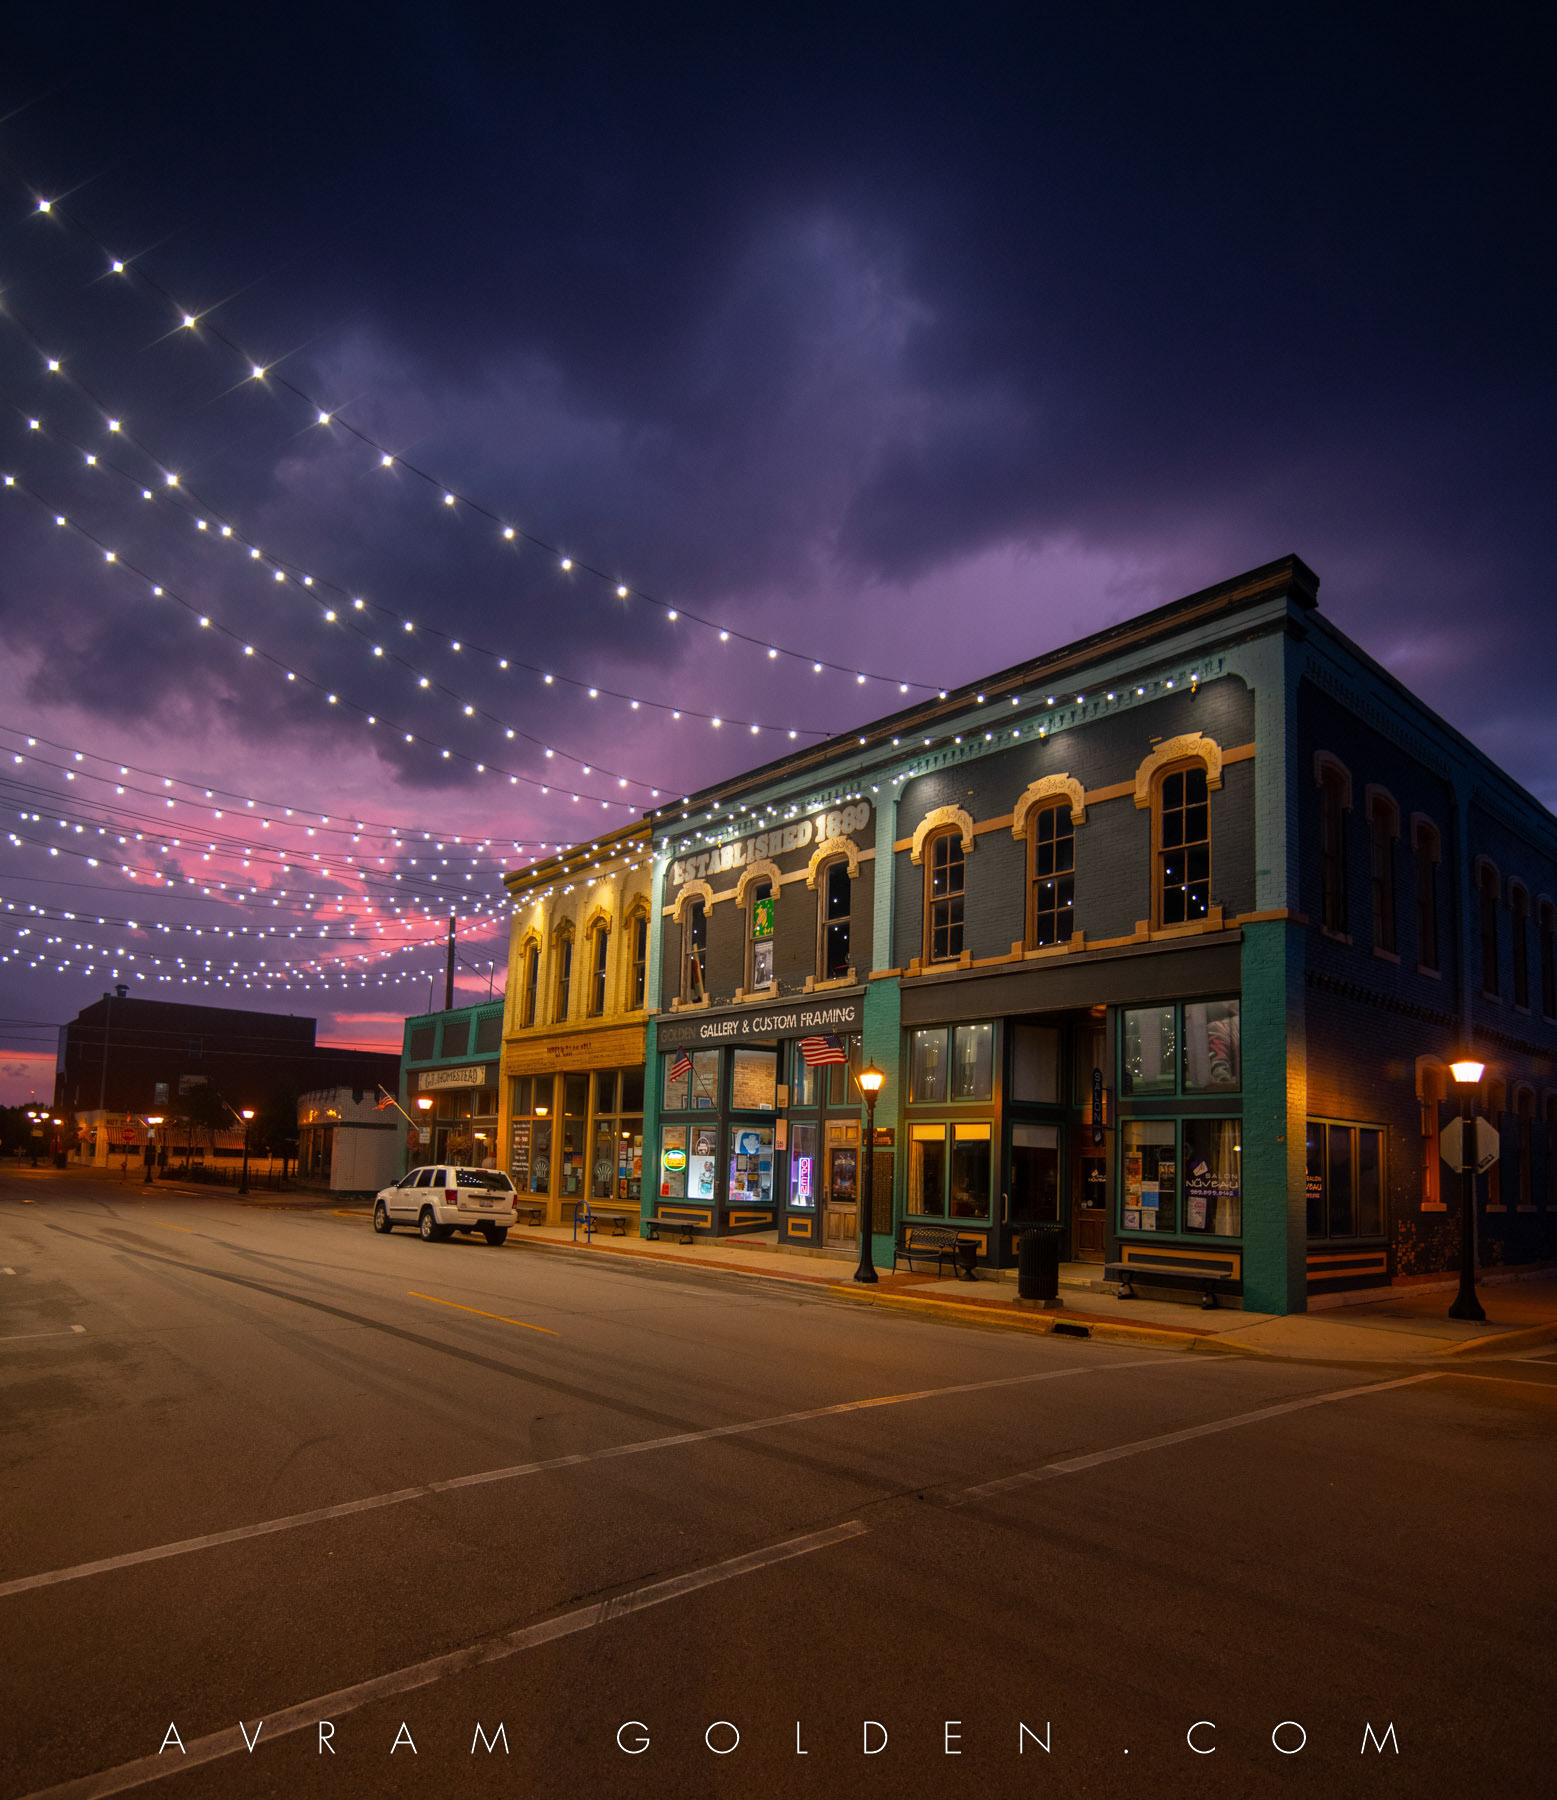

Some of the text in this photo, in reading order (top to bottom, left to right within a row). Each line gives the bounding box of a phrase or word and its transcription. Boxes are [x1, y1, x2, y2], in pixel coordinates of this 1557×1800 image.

[673, 820, 812, 886] ESTABLISHED
[661, 1006, 856, 1044] GOLDEN GALLERY & CUSTOM FRAMING
[437, 1069, 478, 1084] HOMESTEAD
